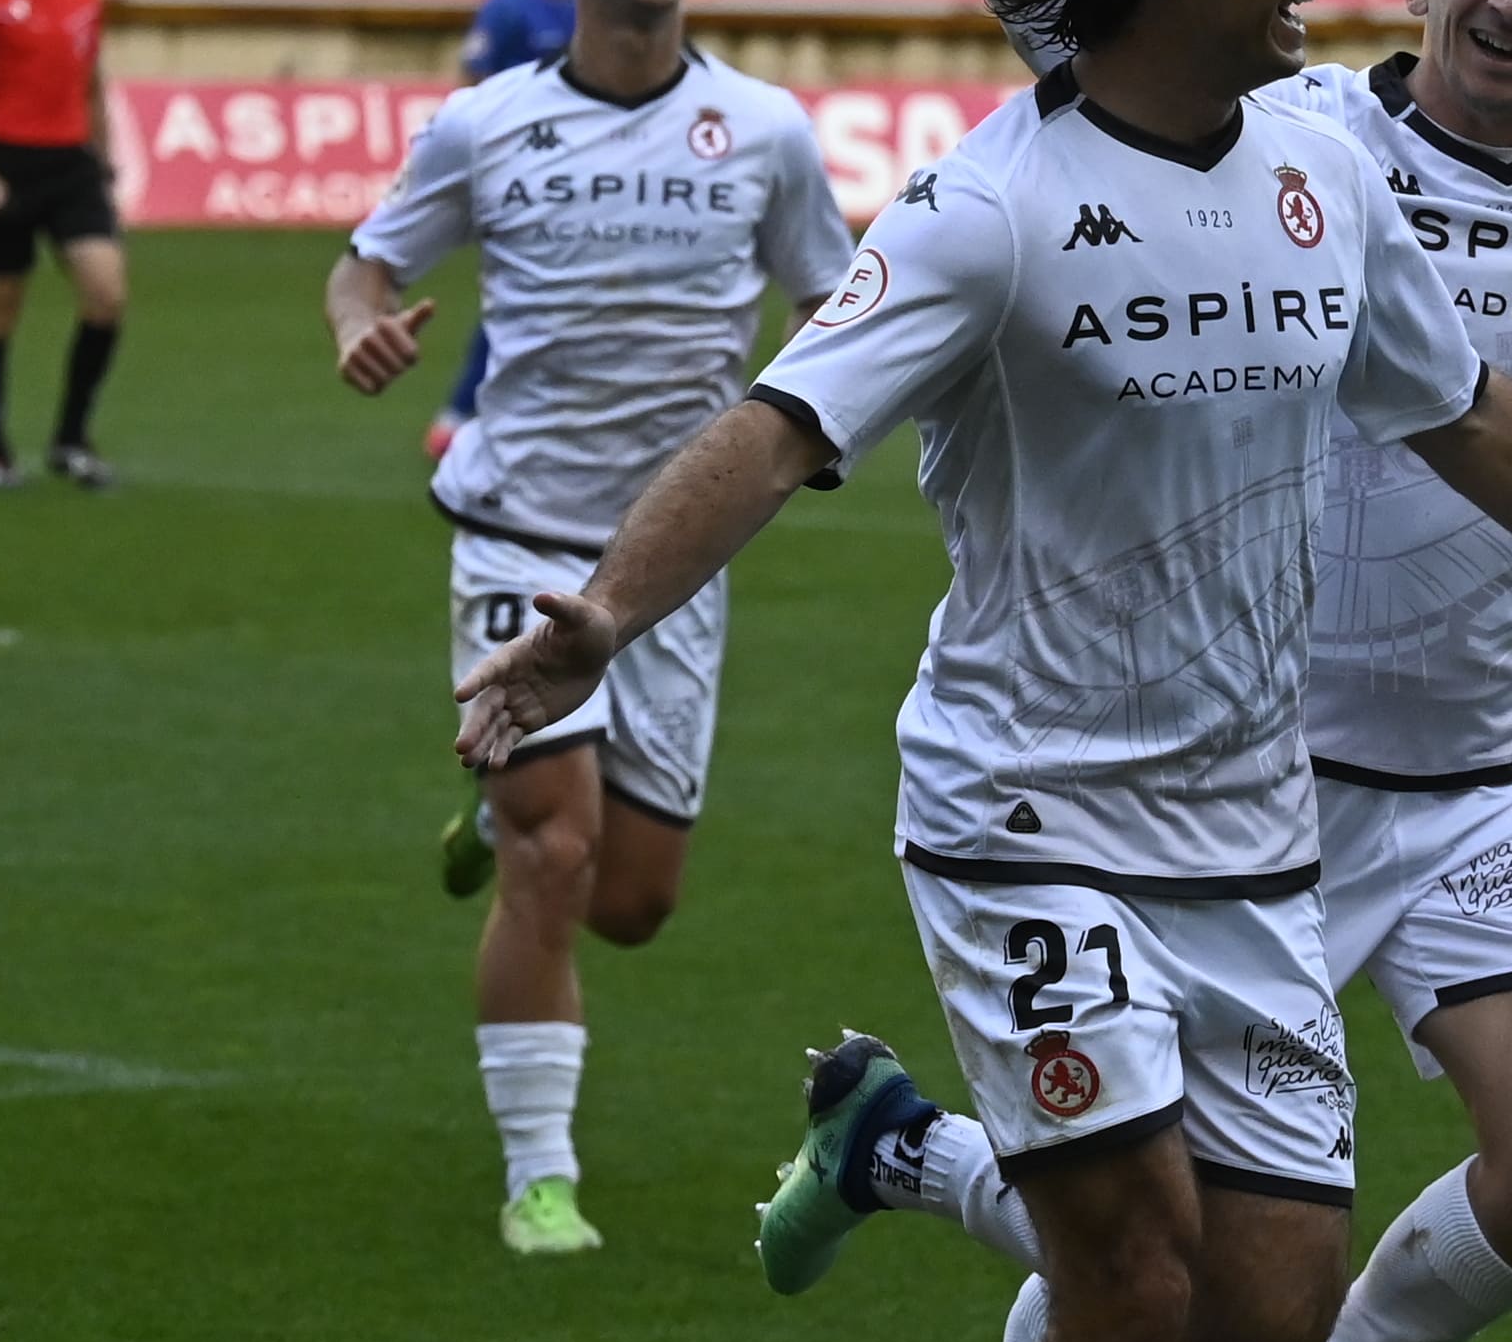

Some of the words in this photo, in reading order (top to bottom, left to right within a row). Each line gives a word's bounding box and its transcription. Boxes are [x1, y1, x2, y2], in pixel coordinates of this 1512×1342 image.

[1186, 209, 1234, 229] 1923
[1117, 363, 1327, 402] ACADEMY
[1003, 919, 1130, 1034] 21
